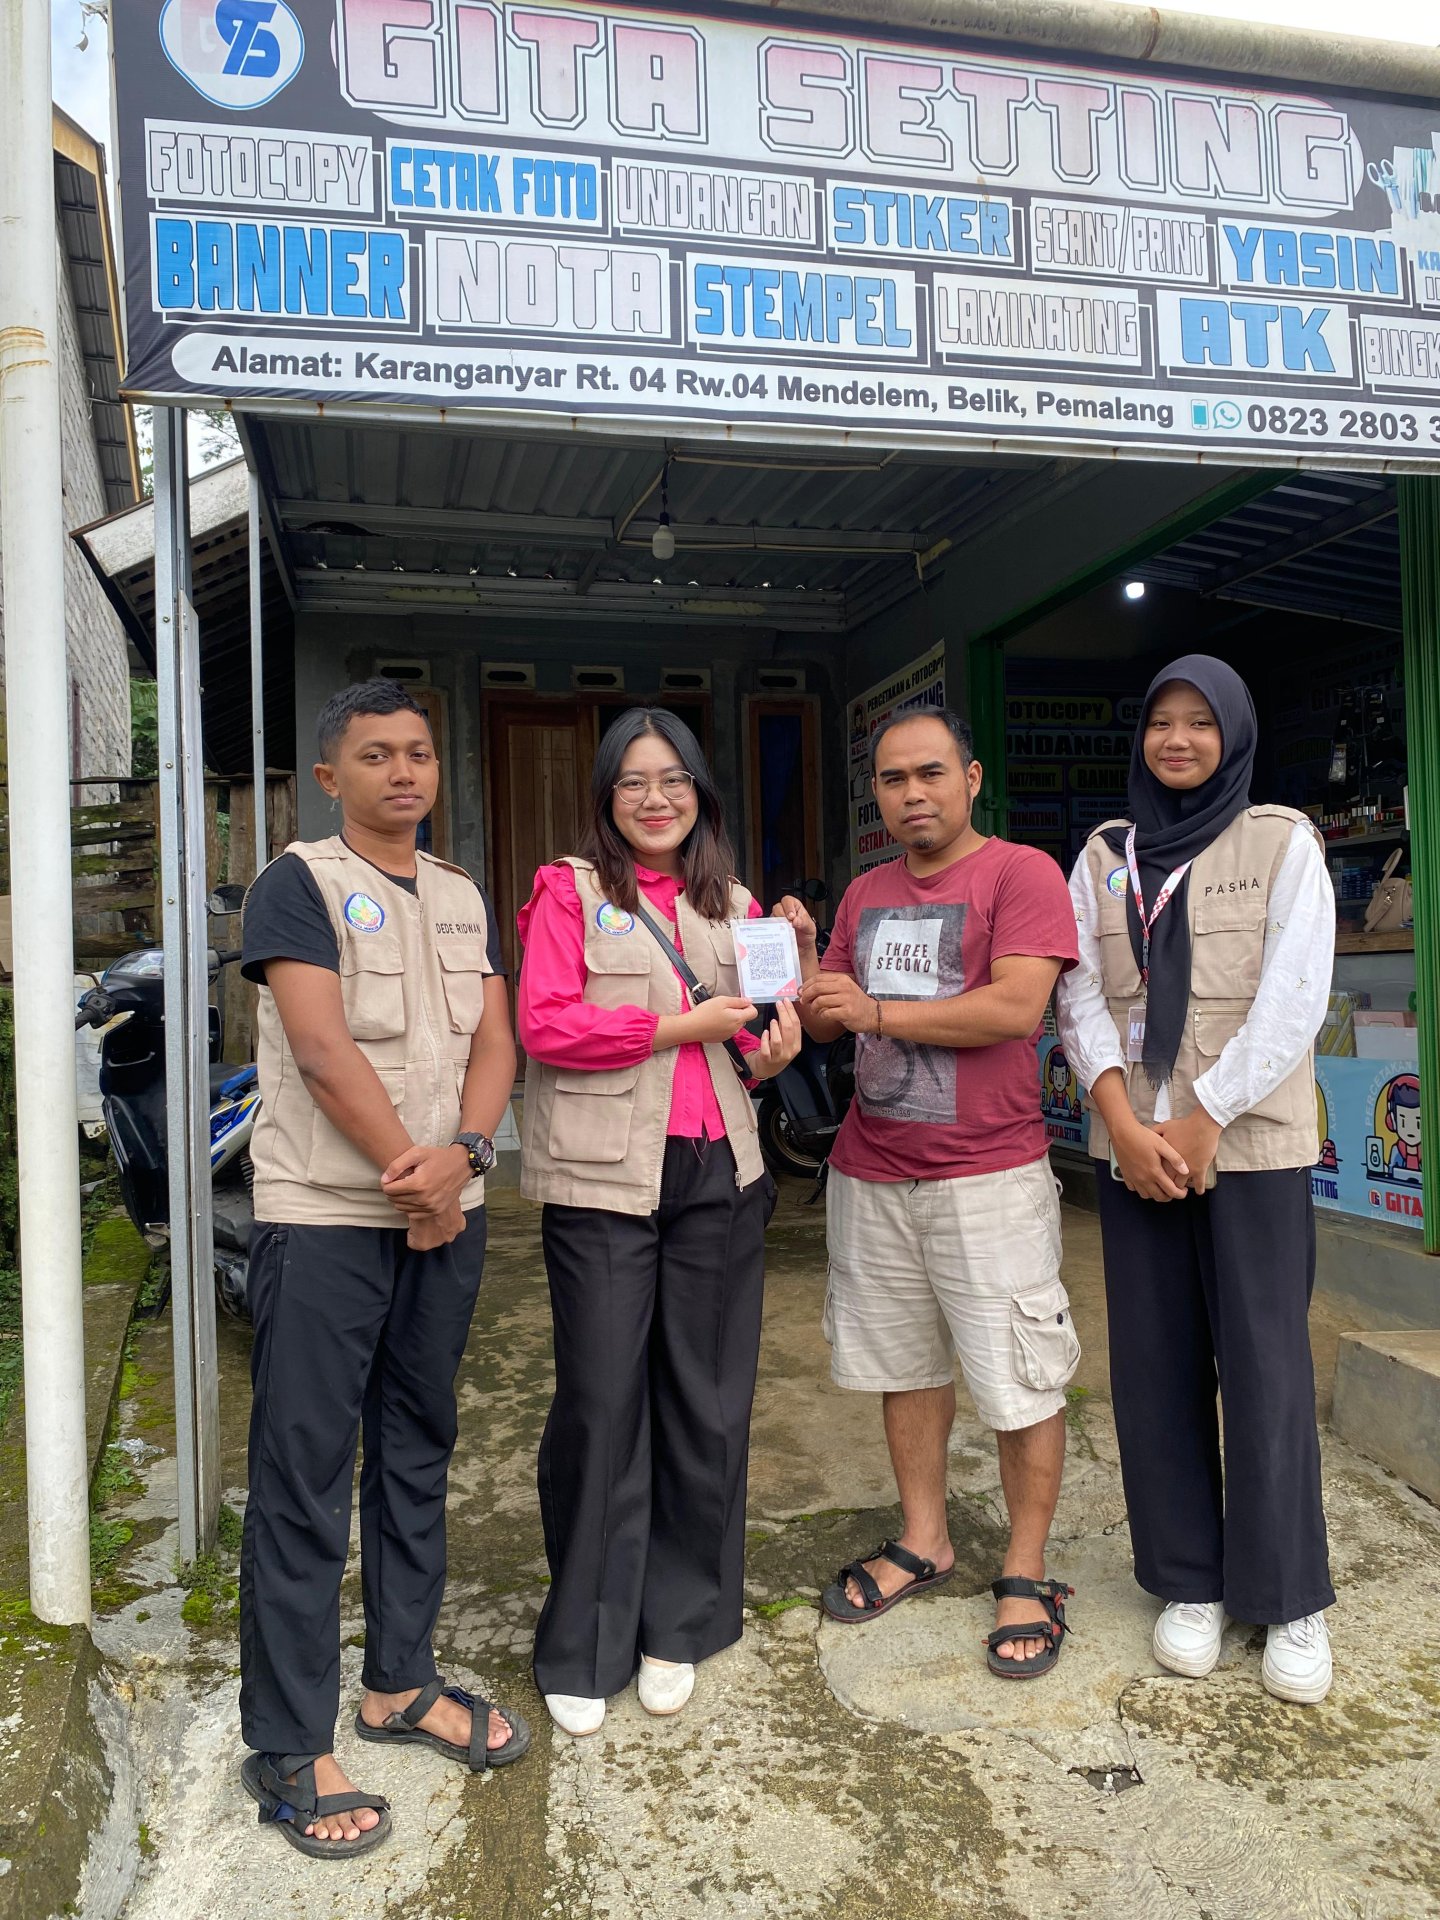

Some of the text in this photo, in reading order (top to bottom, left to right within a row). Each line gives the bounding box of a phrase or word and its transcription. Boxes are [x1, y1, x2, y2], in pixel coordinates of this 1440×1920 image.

[340, 0, 1354, 211] GITA SETTING
[148, 130, 370, 206] FOTOCOPY
[391, 146, 598, 221] CETAK FOTO
[616, 164, 812, 241] UNDANGAN
[833, 186, 1013, 257] STIKER
[1034, 206, 1206, 277] SCANT/PRINT
[156, 218, 406, 321] BANNER
[436, 237, 663, 334] NOTA
[1222, 224, 1399, 296] YASIN
[694, 262, 912, 349] STEMPEL
[937, 285, 1139, 358] LAMINATING
[1179, 298, 1336, 374] ATK
[211, 345, 1175, 430] Alamat: Karanganyar Rt. 04 Rw.04 Mendelem, Belik, Pemalang
[1247, 403, 1330, 436] 0823
[1339, 409, 1419, 442] 2803
[867, 679, 905, 713] PERCETAKAN
[911, 654, 945, 688] FOTOCOPY
[1005, 701, 1105, 721] OTOCOPY
[1007, 734, 1135, 756] NDANGA
[859, 828, 885, 854] CETAK
[1204, 877, 1261, 897] PASHA
[435, 922, 482, 936] DEDE RIDWAN
[886, 941, 929, 959] THREE
[876, 956, 932, 974] SECOND
[1365, 1060, 1413, 1128] PERCETAKAN
[1385, 1191, 1424, 1218] GITA
